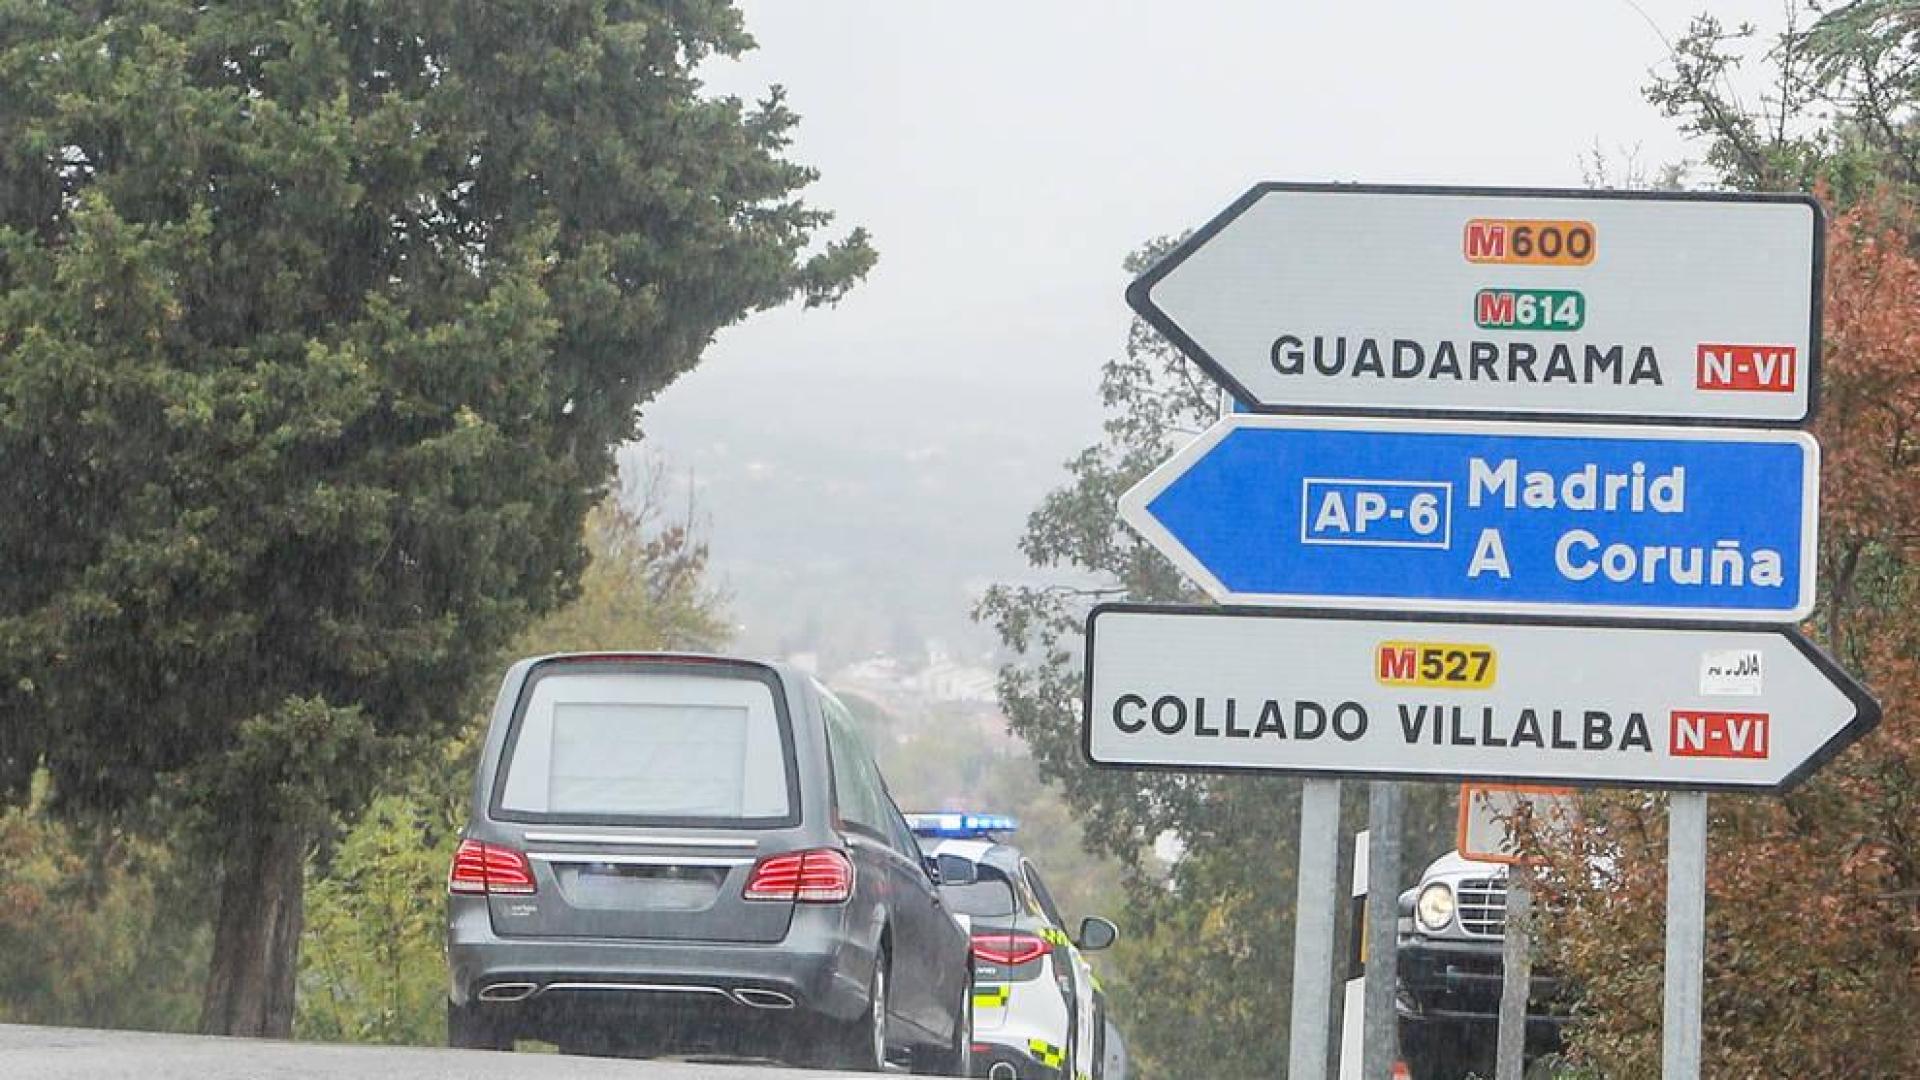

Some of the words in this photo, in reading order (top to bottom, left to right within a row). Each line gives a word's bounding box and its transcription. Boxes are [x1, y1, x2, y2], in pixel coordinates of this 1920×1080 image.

[1468, 223, 1592, 259] M600
[1478, 292, 1580, 327] M614
[1270, 334, 1663, 386] GUADARRAMA
[1703, 350, 1792, 386] N-VI
[1468, 457, 1685, 513] Madrid
[1314, 491, 1439, 535] AP-6
[1467, 528, 1512, 579] A
[1555, 529, 1785, 587] Coruña
[1380, 647, 1492, 683] M527
[1112, 693, 1369, 742] COLLADO
[1398, 703, 1653, 752] VILLALBA
[1675, 716, 1766, 754] N-VI
